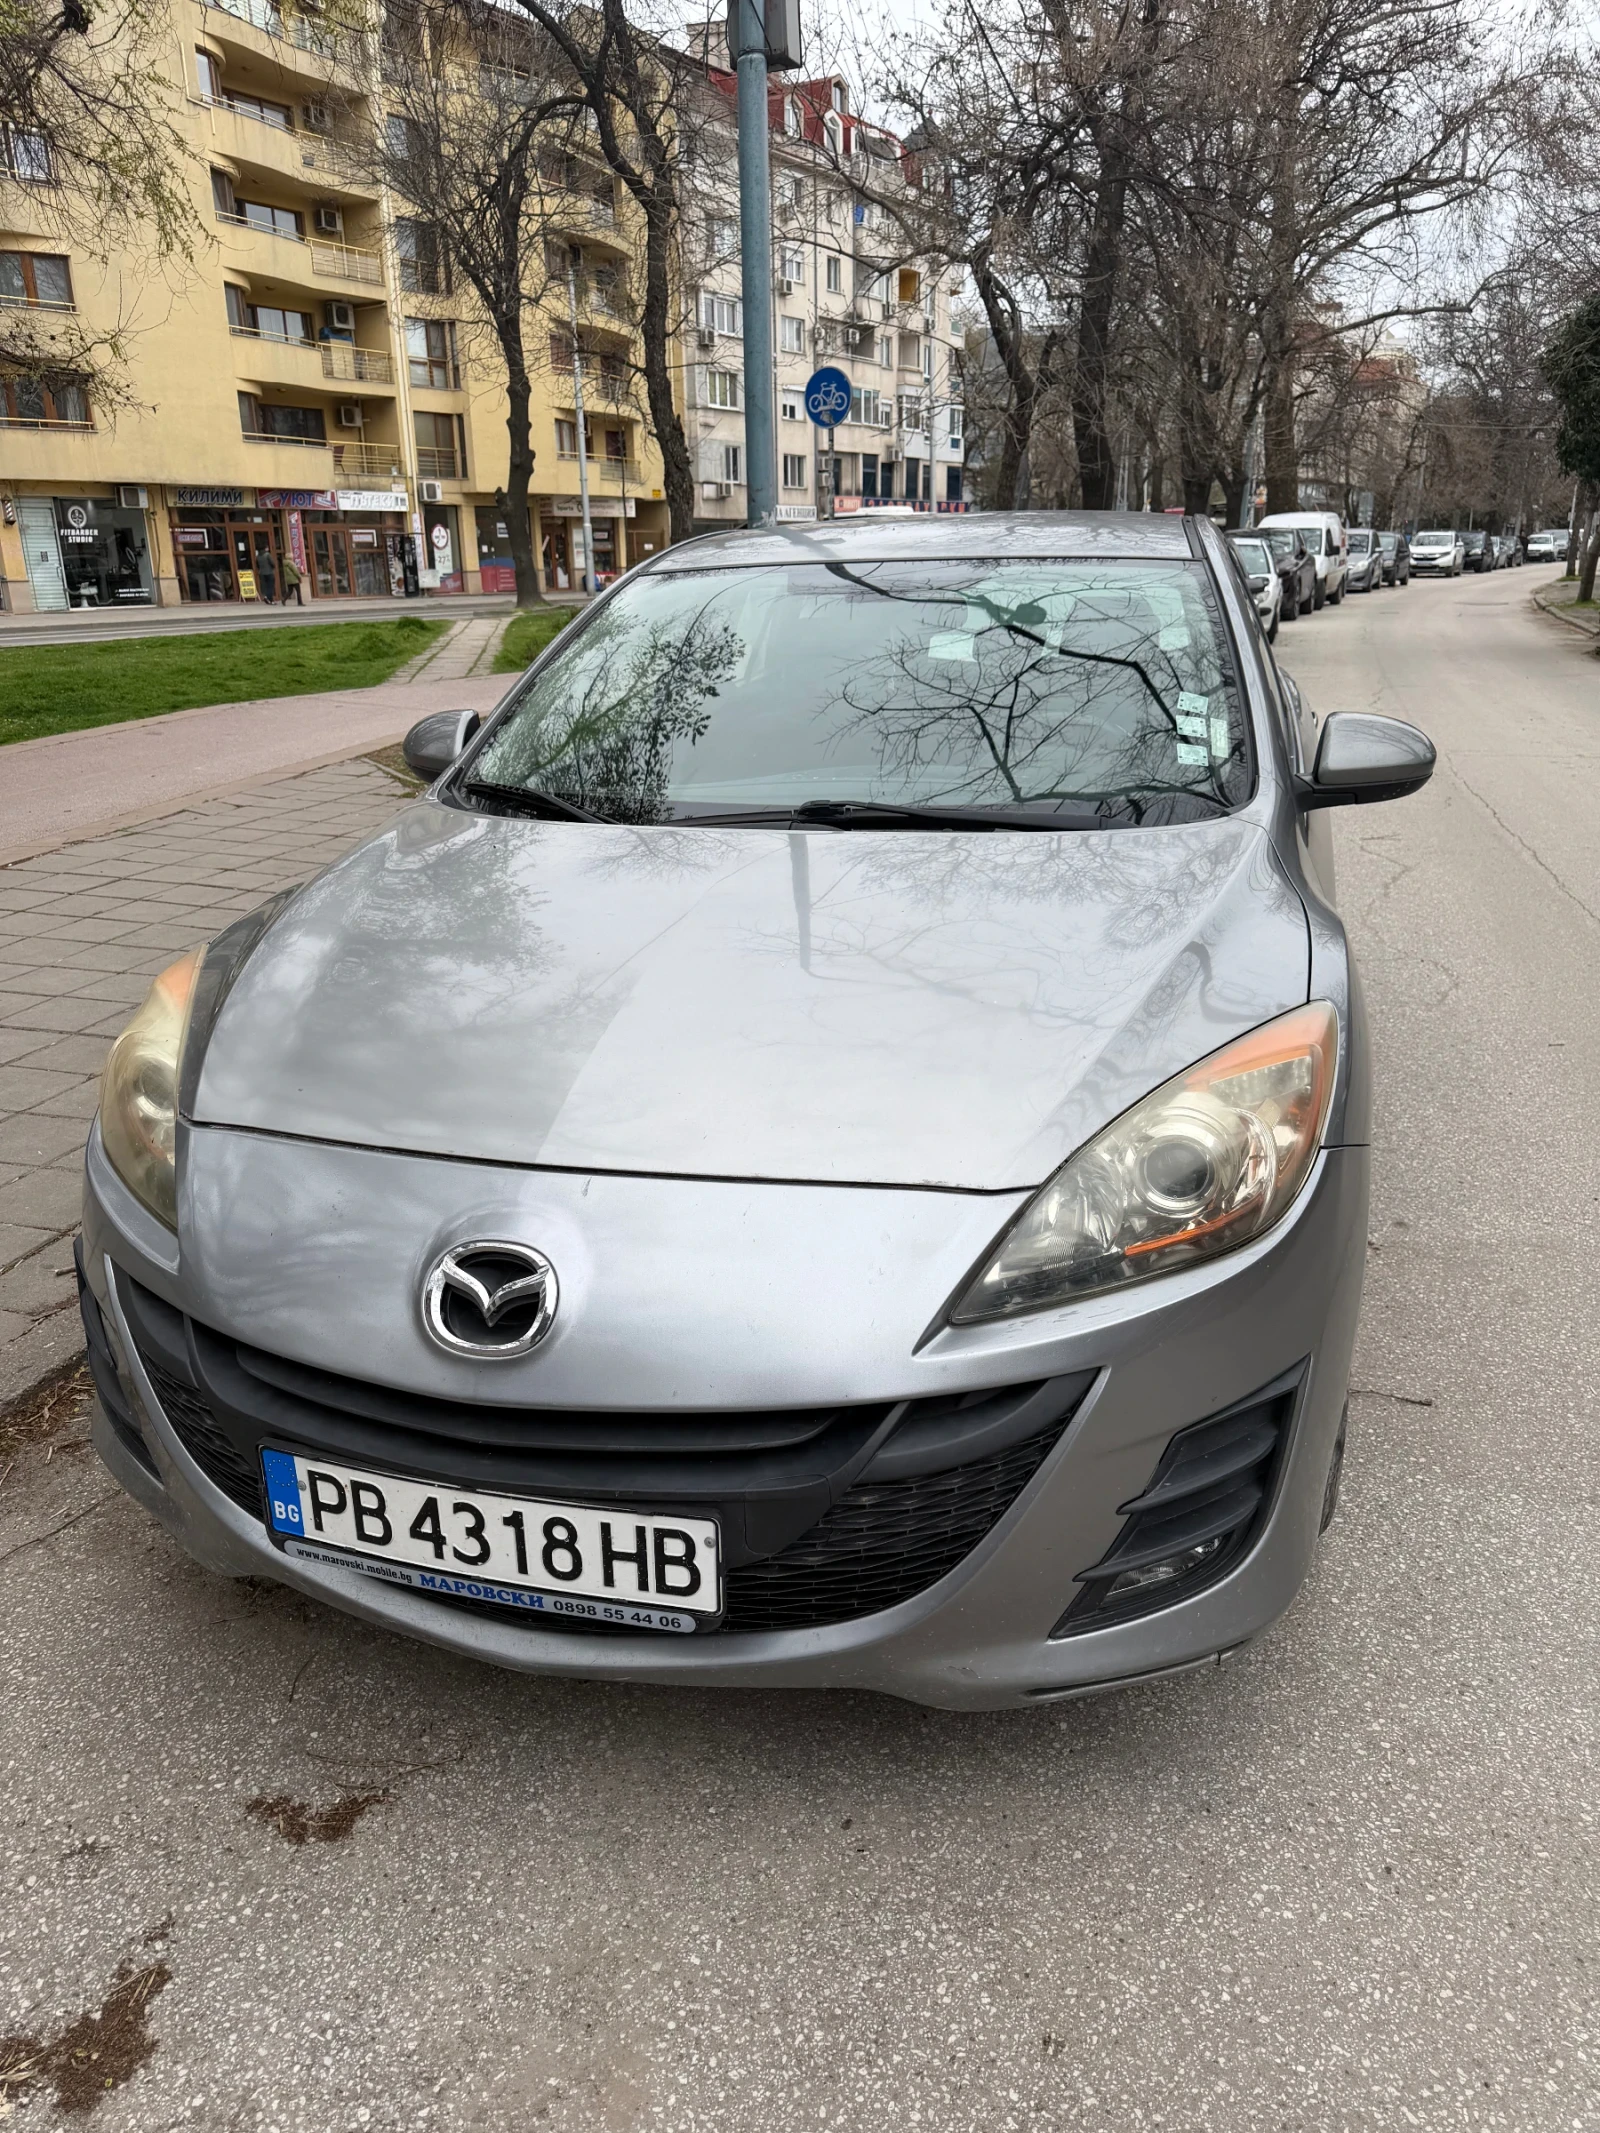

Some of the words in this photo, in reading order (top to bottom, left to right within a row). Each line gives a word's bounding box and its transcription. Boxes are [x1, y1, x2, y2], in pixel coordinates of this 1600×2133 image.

[178, 489, 243, 504] КИЛИМИ
[280, 492, 314, 508] УЮТ
[274, 1500, 300, 1523] BG
[306, 1468, 393, 1546] PB
[409, 1495, 583, 1582] 4318
[600, 1521, 701, 1597] HB
[296, 1547, 413, 1583] www.marovski.mobile.bg
[419, 1573, 545, 1609] МАРОВСКИ
[553, 1600, 597, 1616] 0898
[603, 1607, 625, 1620] 55
[630, 1612, 653, 1625] 44
[659, 1616, 682, 1629] 06
